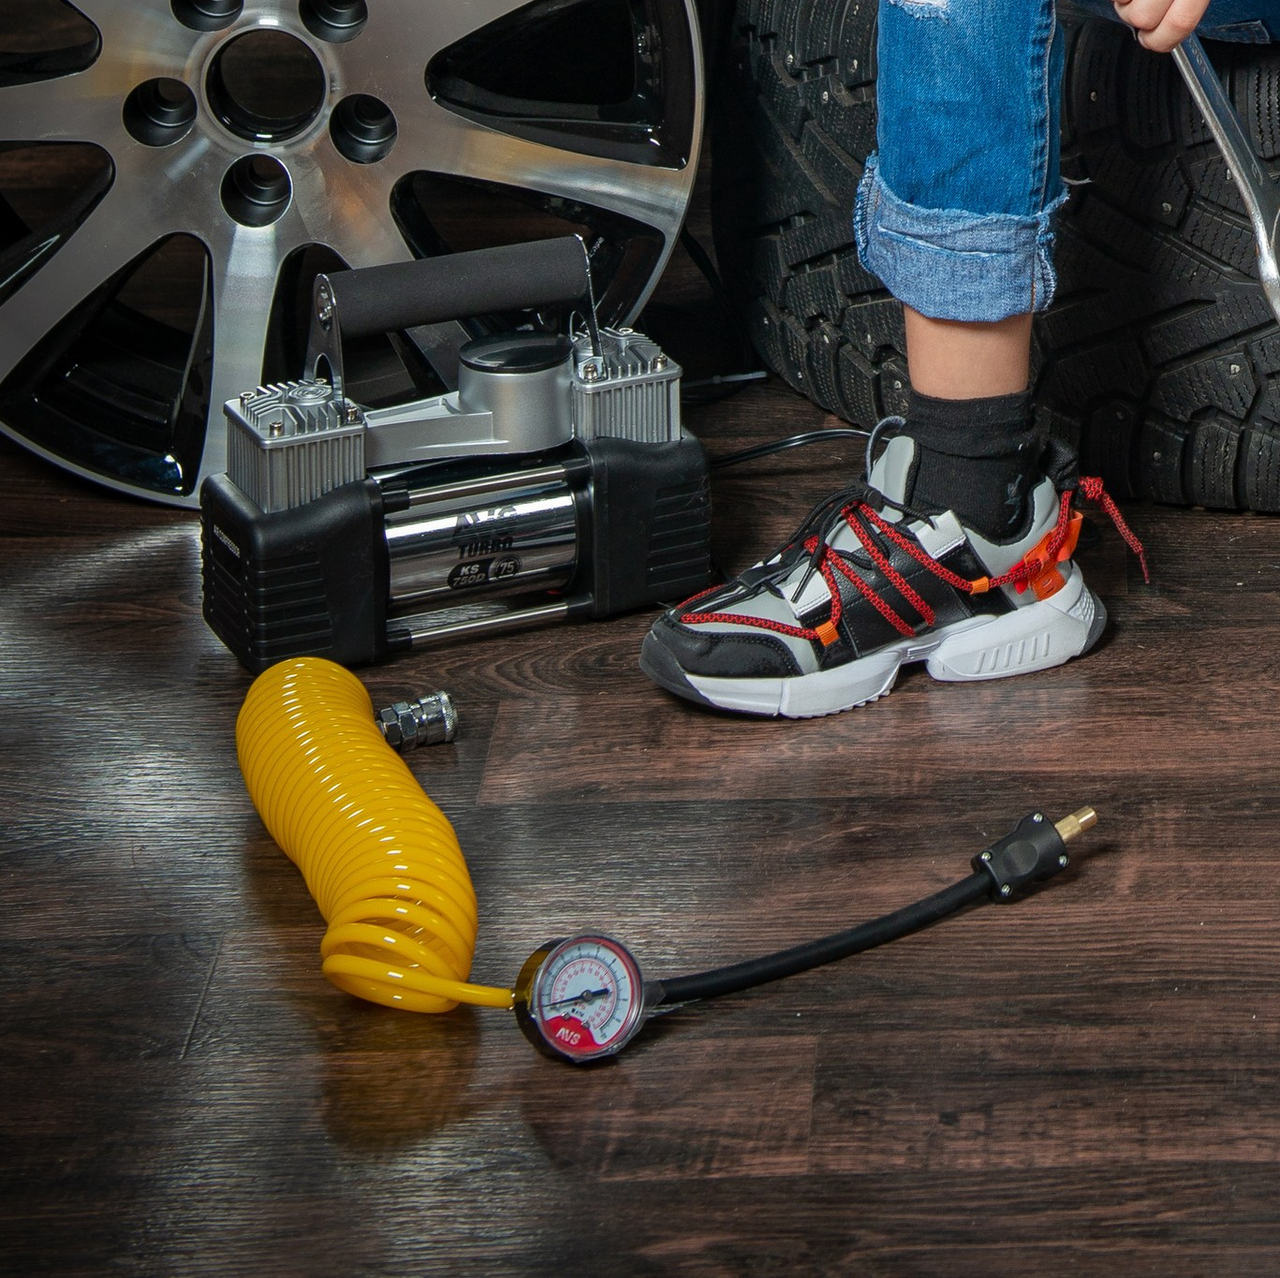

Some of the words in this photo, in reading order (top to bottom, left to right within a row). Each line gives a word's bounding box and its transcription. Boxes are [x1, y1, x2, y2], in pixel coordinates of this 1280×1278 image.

[458, 536, 515, 560] TURBO
[460, 564, 480, 576] KS
[500, 561, 515, 574] 75
[453, 573, 486, 587] 750D
[555, 1026, 581, 1046] AVS
